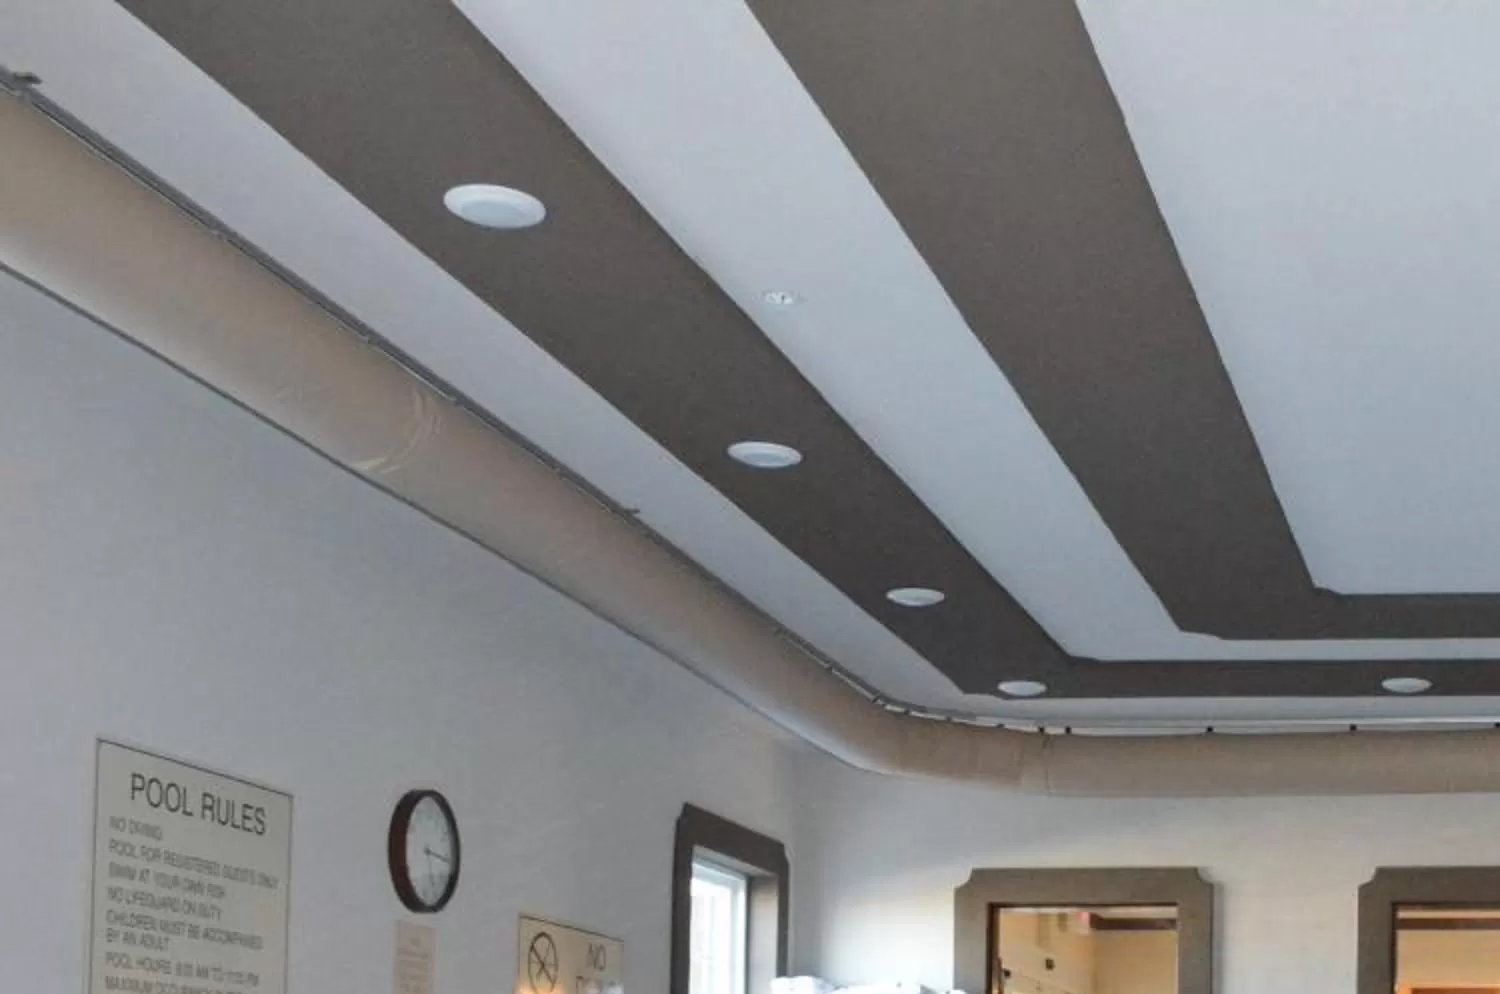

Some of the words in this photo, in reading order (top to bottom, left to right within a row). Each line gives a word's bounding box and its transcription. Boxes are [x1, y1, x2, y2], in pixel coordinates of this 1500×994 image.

[130, 772, 194, 816] POOL
[200, 791, 267, 835] RULES
[109, 816, 127, 832] NO
[109, 839, 137, 858] POOL
[140, 845, 161, 860] FOR
[105, 951, 134, 970] POOL
[587, 943, 606, 972] NO
